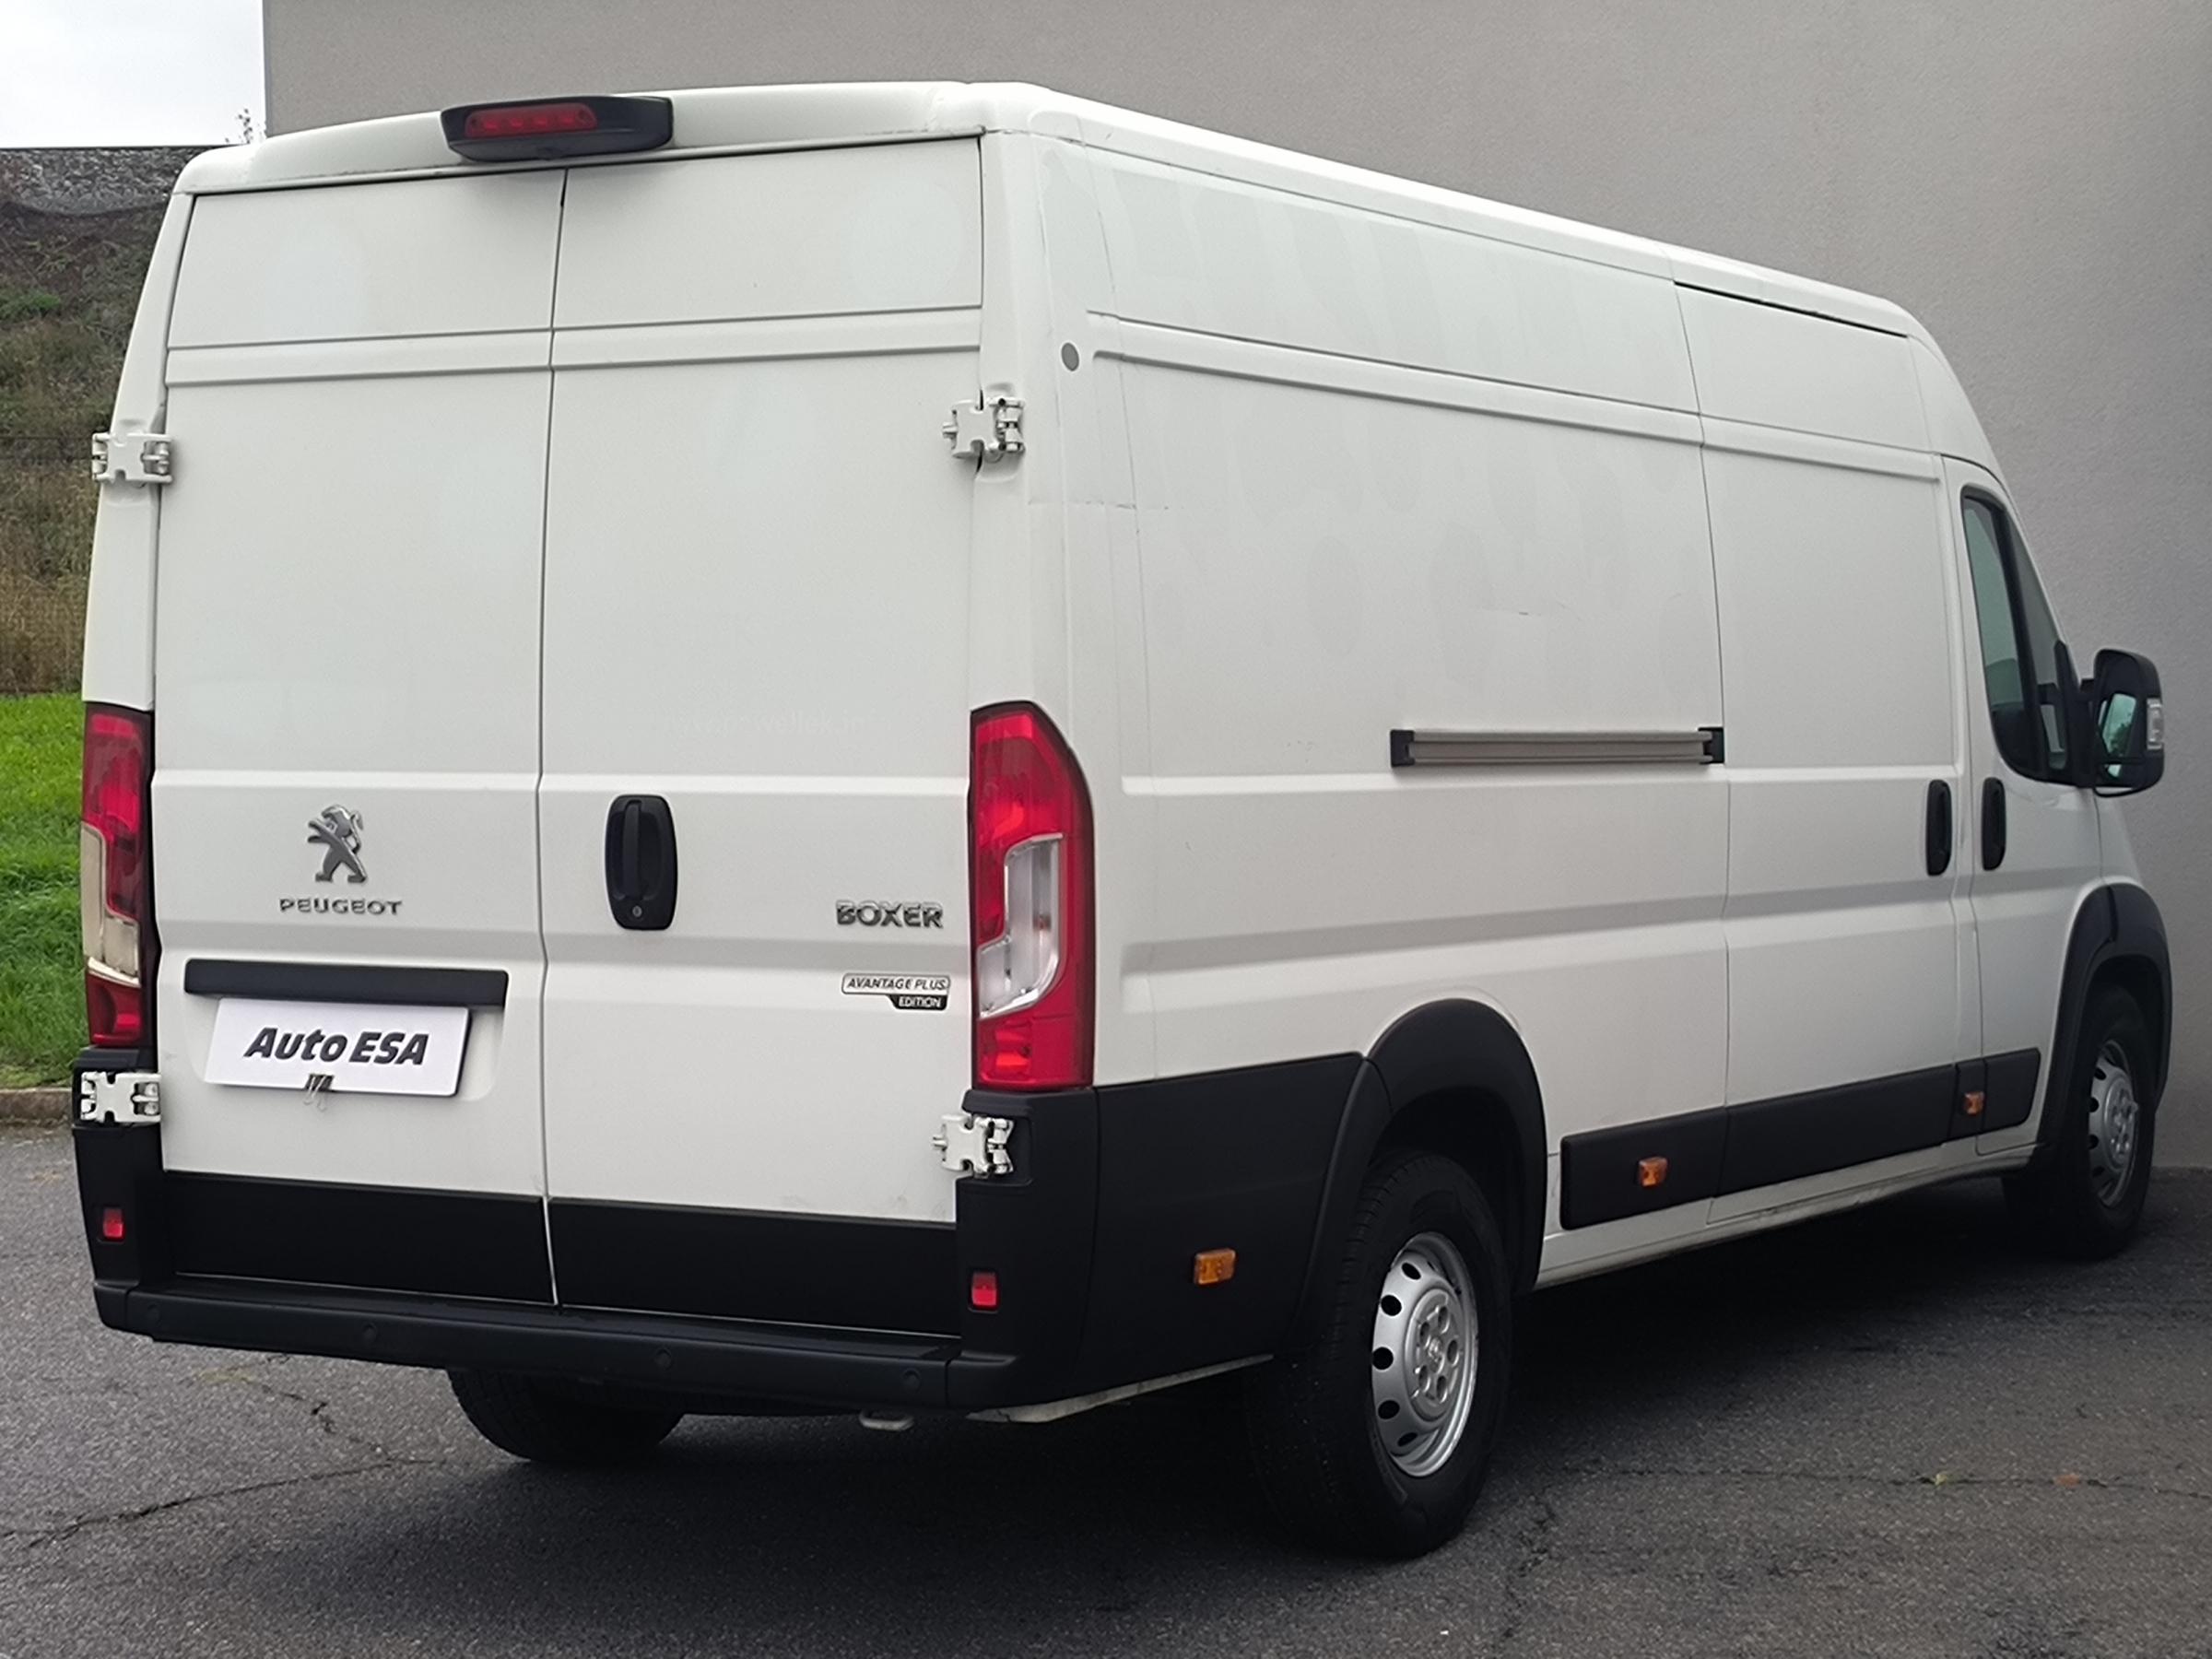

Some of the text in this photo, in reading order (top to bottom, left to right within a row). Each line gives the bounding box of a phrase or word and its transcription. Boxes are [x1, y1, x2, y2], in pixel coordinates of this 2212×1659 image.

[279, 898, 403, 915] PEUGEOT
[835, 900, 944, 929] BOXER
[846, 978, 947, 991] AVANTAGE PLUS
[898, 997, 941, 1007] EDITION
[243, 1027, 429, 1065] Auto ESA
